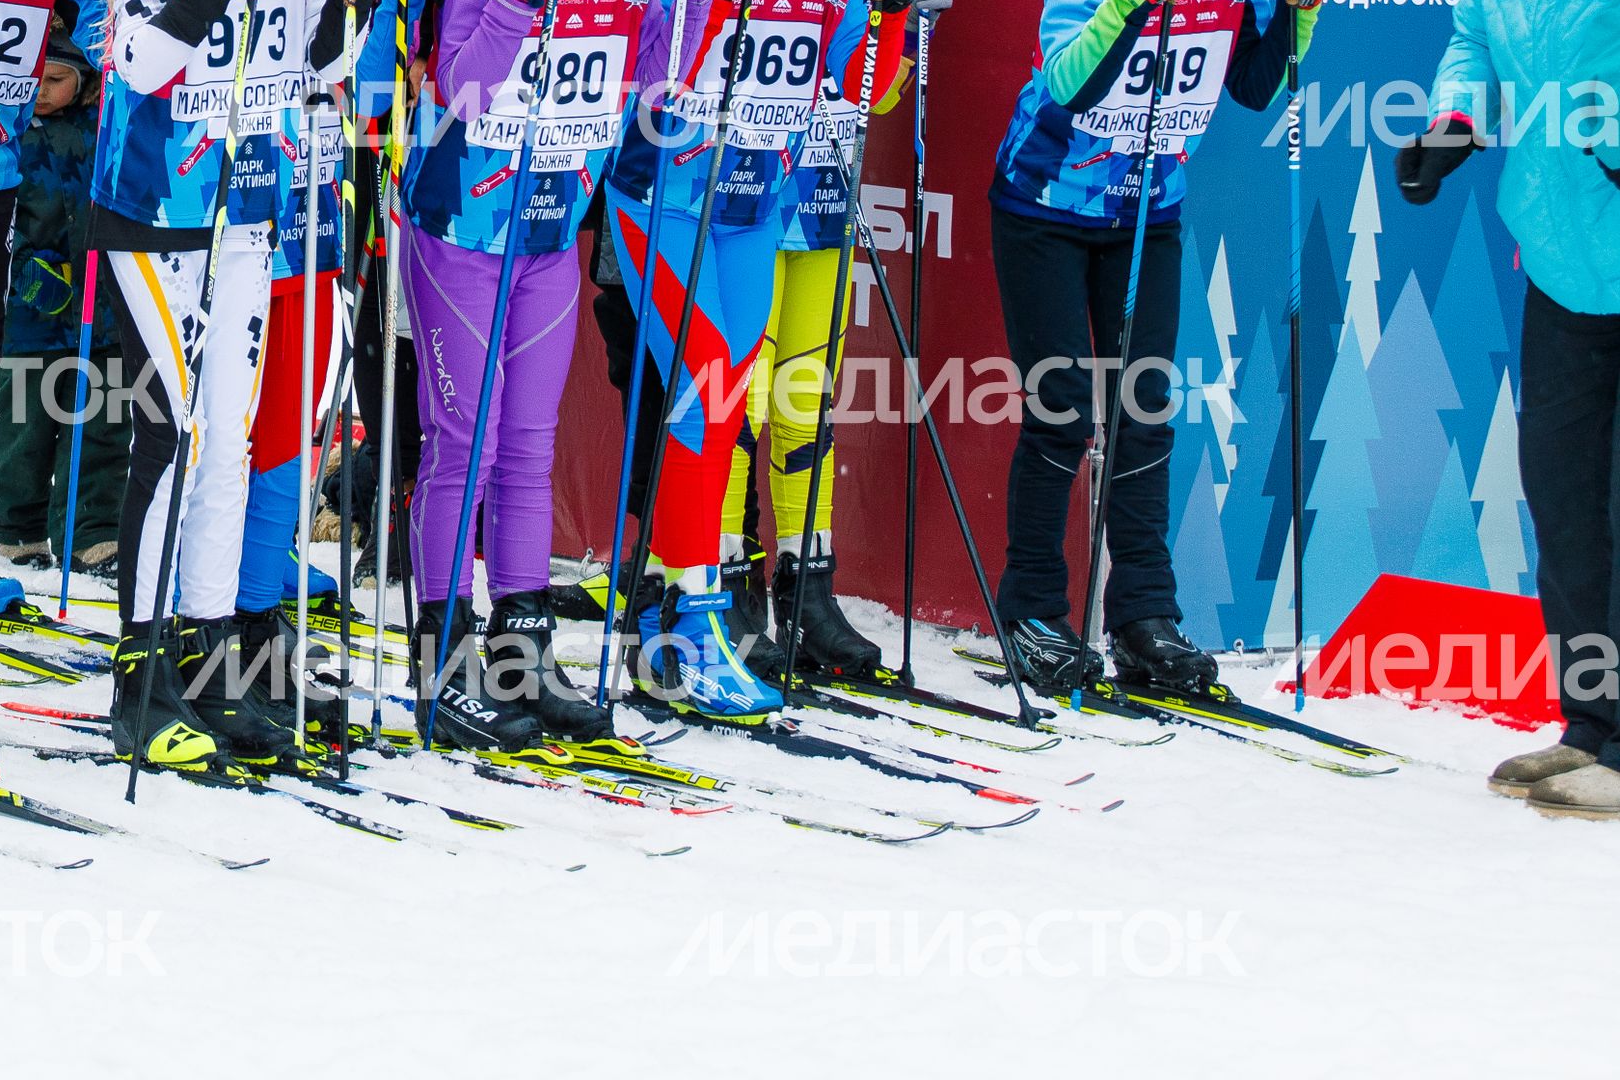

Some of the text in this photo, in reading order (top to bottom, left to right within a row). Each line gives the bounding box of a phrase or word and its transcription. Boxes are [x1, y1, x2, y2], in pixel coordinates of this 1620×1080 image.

[207, 6, 288, 68] 973
[719, 34, 819, 87] 969
[919, 20, 930, 83] NORDWAY
[518, 51, 608, 105] 980
[855, 32, 880, 129] NORDWAY
[1125, 46, 1207, 96] 919
[729, 134, 775, 148] ЛЫЖНЯ
[234, 159, 263, 174] ПАРК
[729, 170, 758, 183] ПАРК
[530, 194, 558, 208] ПАРК
[814, 188, 840, 201] ПАРК
[722, 563, 752, 575] SPINE
[506, 616, 548, 629] TISA
[118, 647, 165, 663] FISCHR
[1013, 630, 1060, 664] SPINE
[678, 662, 755, 711] SPINE
[440, 685, 499, 723] TISA
[711, 724, 753, 740] ATOMIC
